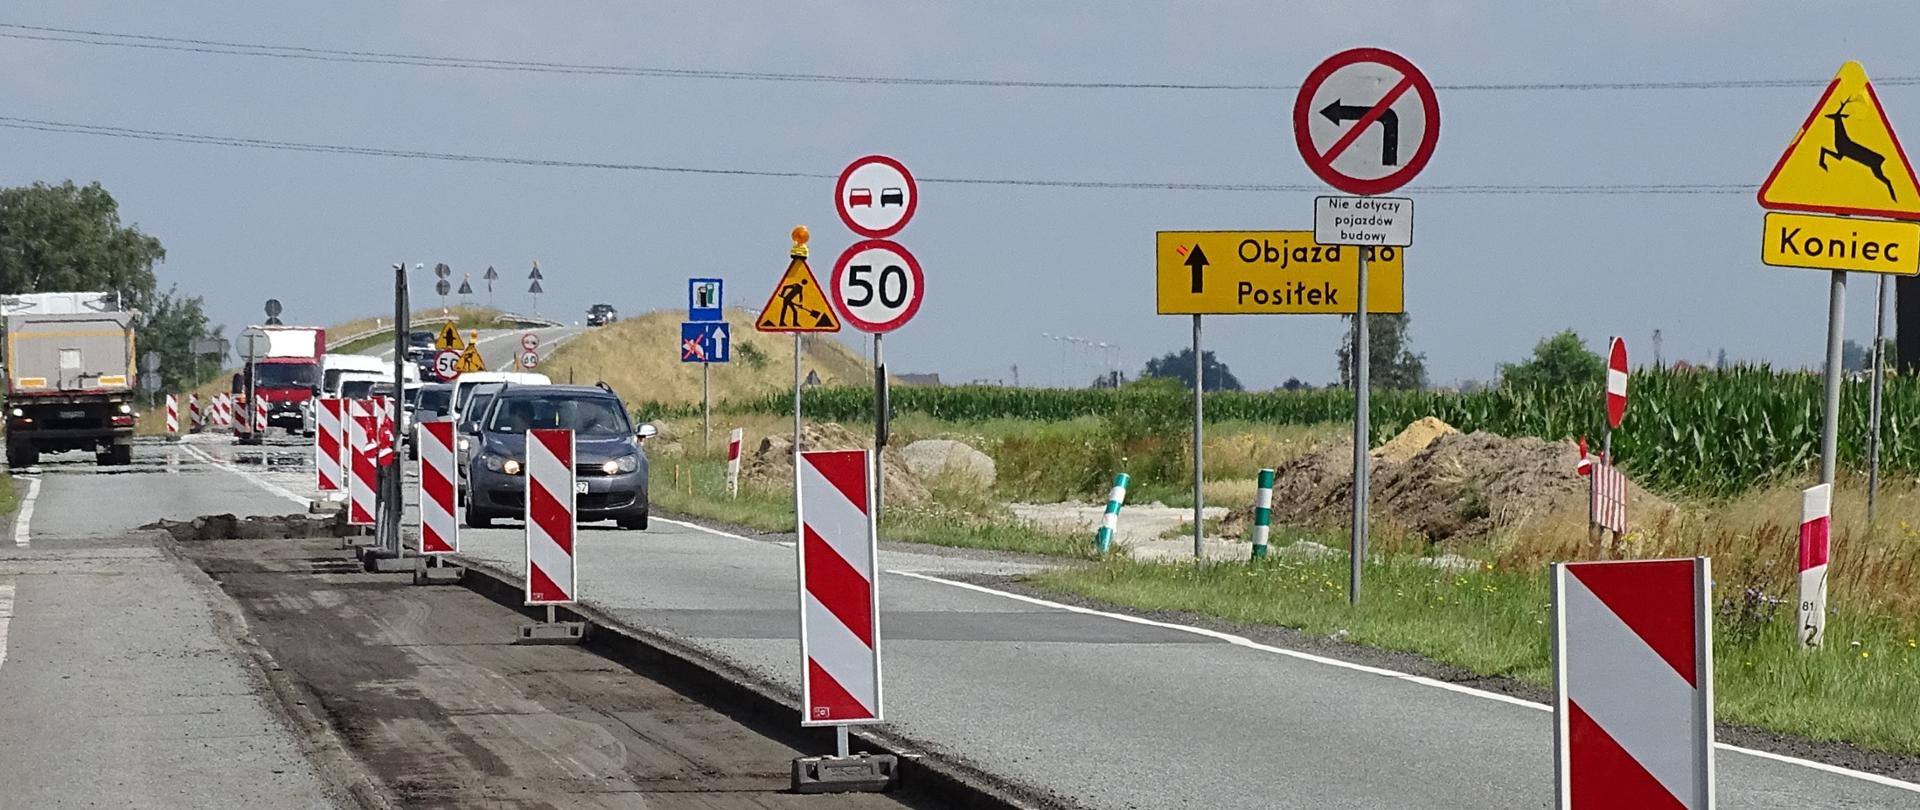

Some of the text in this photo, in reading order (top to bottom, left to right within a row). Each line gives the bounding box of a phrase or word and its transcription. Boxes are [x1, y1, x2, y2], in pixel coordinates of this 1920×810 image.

[1328, 199, 1401, 213] Nie dotyczy
[1335, 214, 1393, 228] pojazdów
[1340, 230, 1386, 244] budowy
[1780, 227, 1899, 262] Koniec
[1238, 239, 1341, 269] Objazd
[847, 265, 908, 309] 50
[1238, 281, 1338, 305] Posiłek
[439, 357, 458, 371] 50
